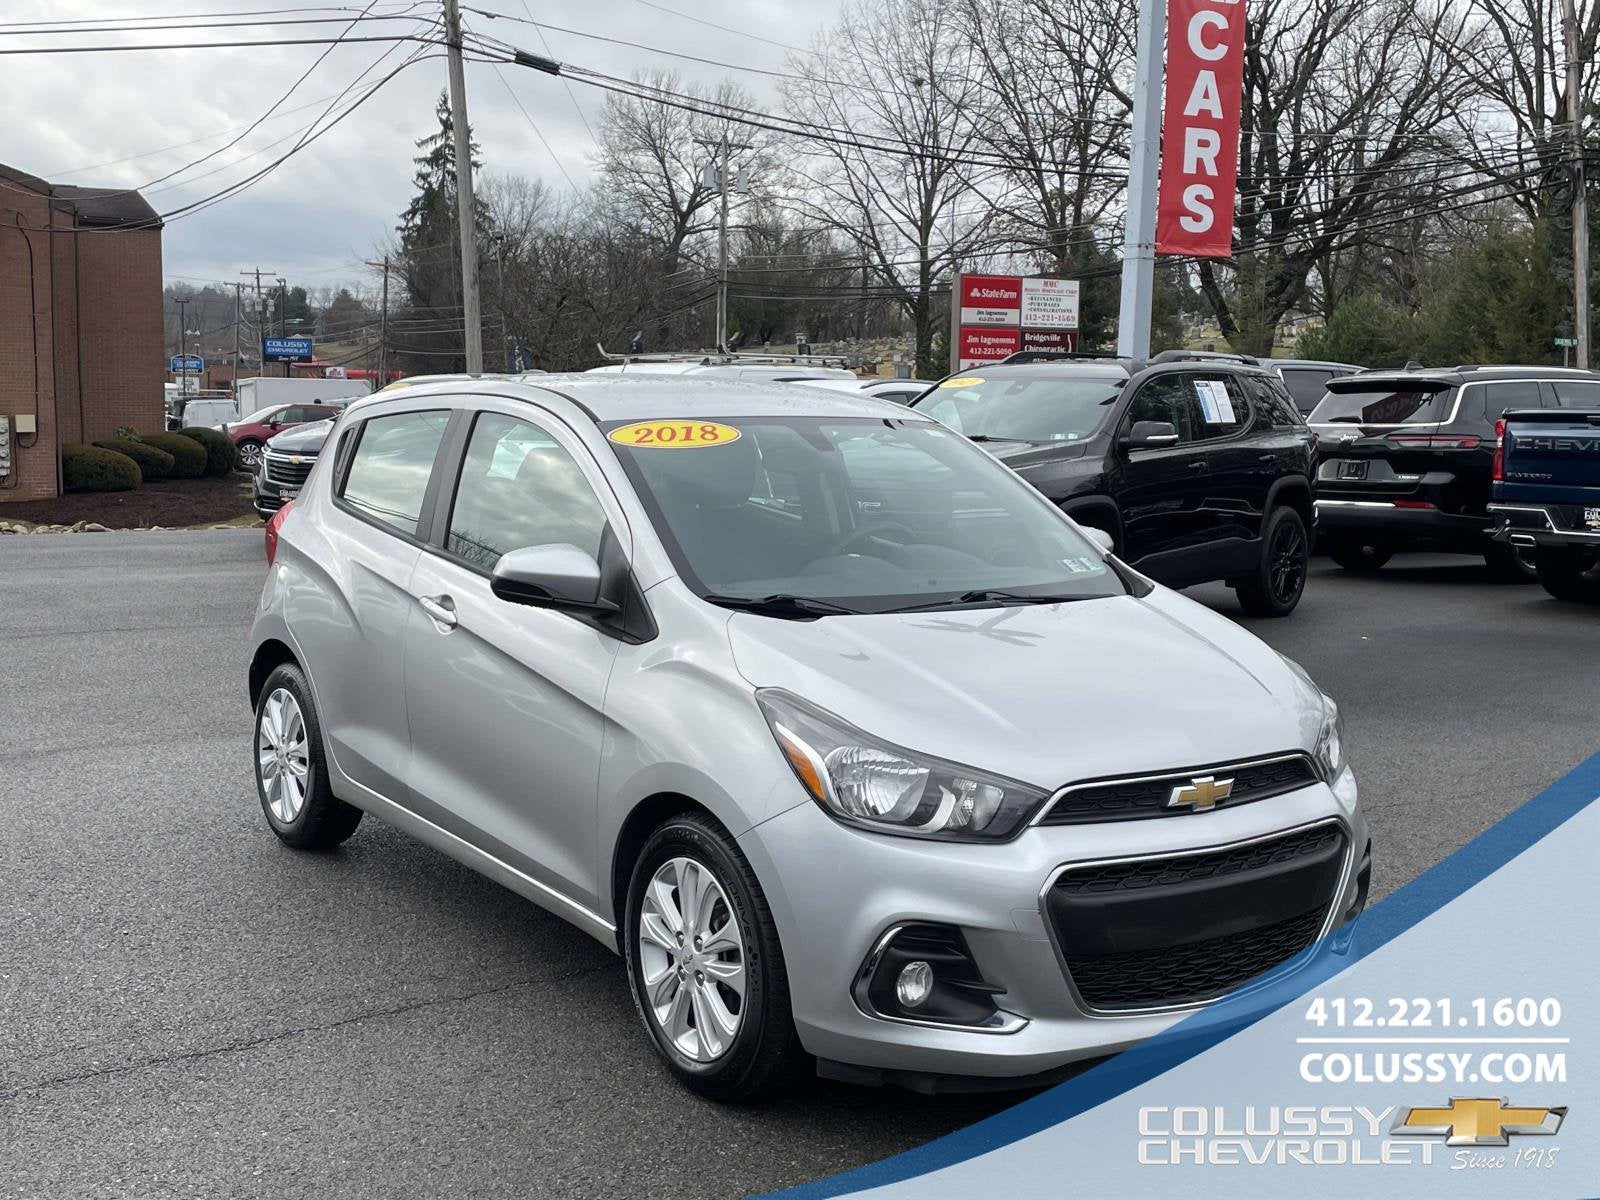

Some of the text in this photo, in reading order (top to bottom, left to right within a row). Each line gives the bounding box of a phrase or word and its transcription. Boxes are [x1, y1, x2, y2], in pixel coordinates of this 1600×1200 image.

[1179, 10, 1229, 234] CARS
[966, 335, 980, 343] Jim
[1024, 333, 1061, 342] Bridgeville
[267, 340, 309, 348] COLUSSY
[634, 425, 719, 444] 2018
